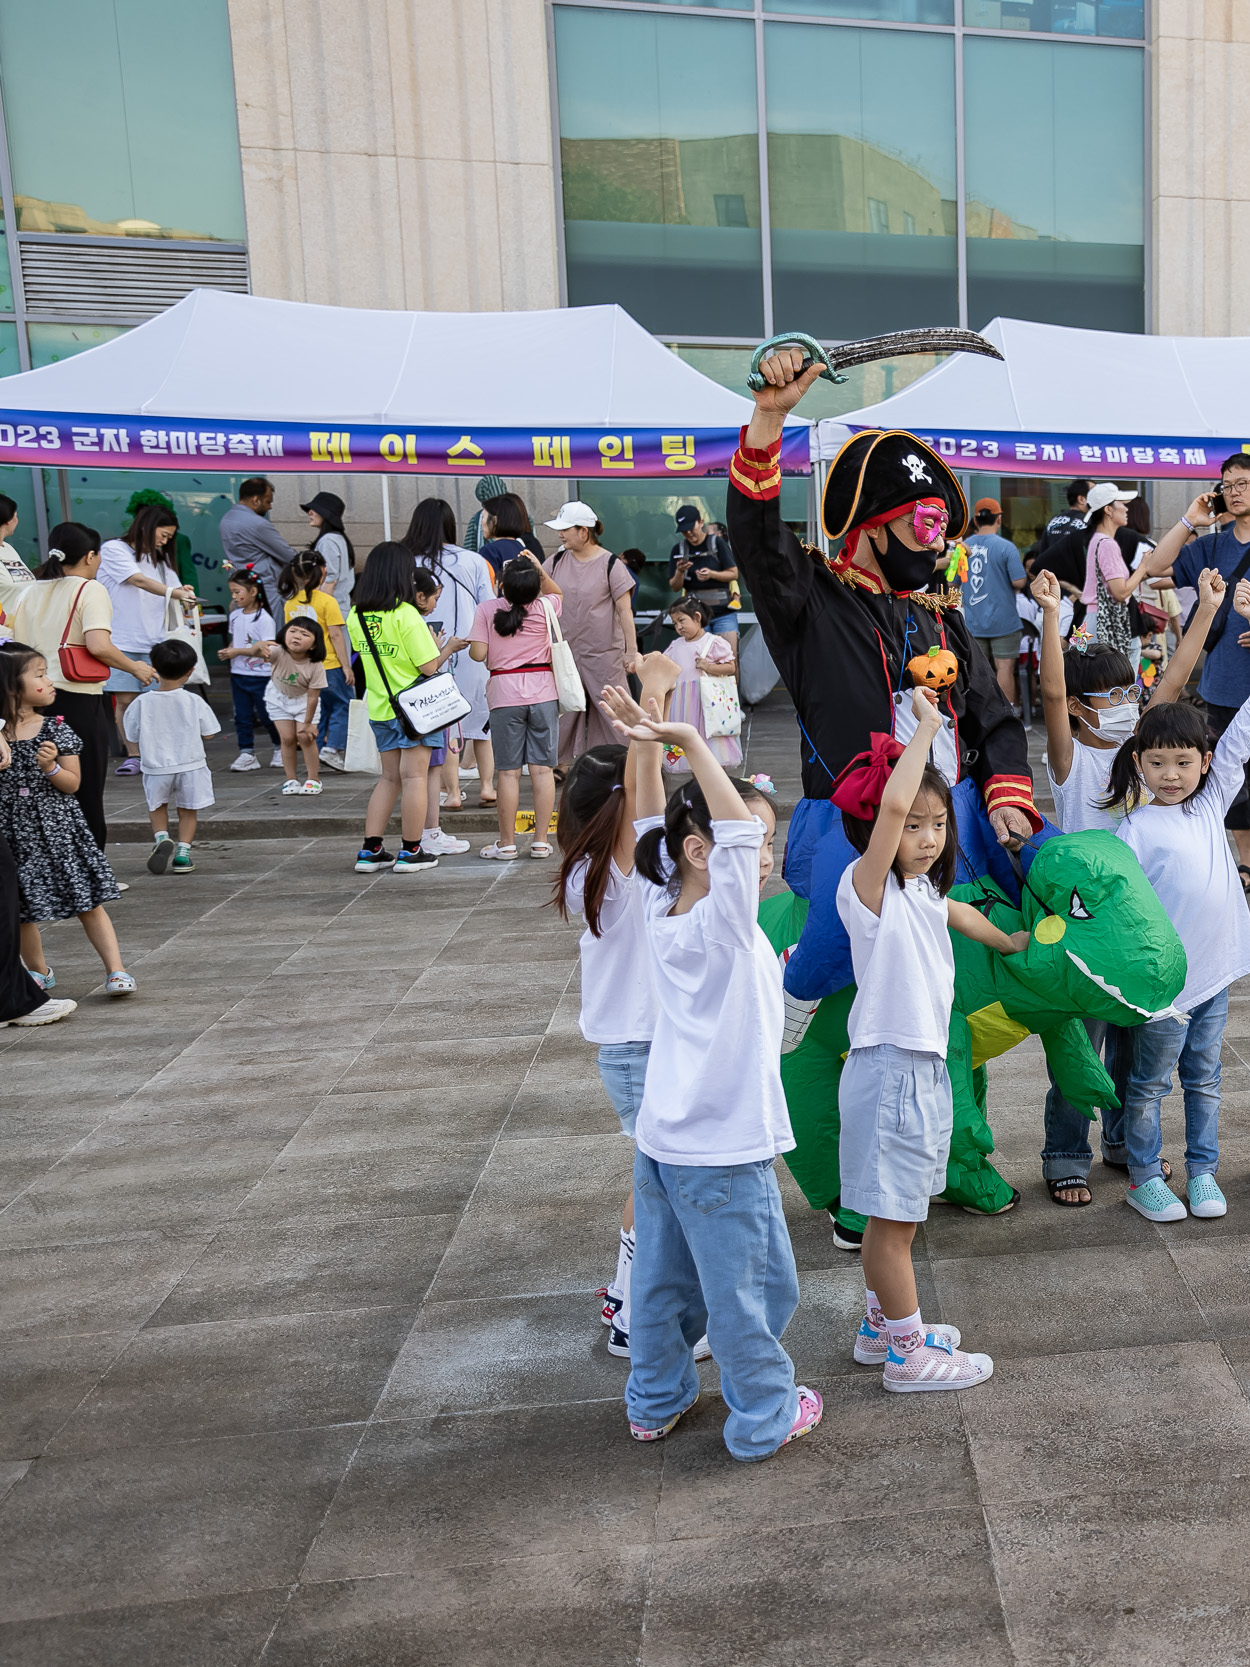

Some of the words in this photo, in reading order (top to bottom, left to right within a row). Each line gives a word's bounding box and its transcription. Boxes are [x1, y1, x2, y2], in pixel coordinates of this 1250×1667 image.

[71, 427, 130, 452] 군자
[139, 429, 285, 457] 한마당축제
[1015, 442, 1065, 462] 군자
[1078, 445, 1207, 466] 한마당축제
